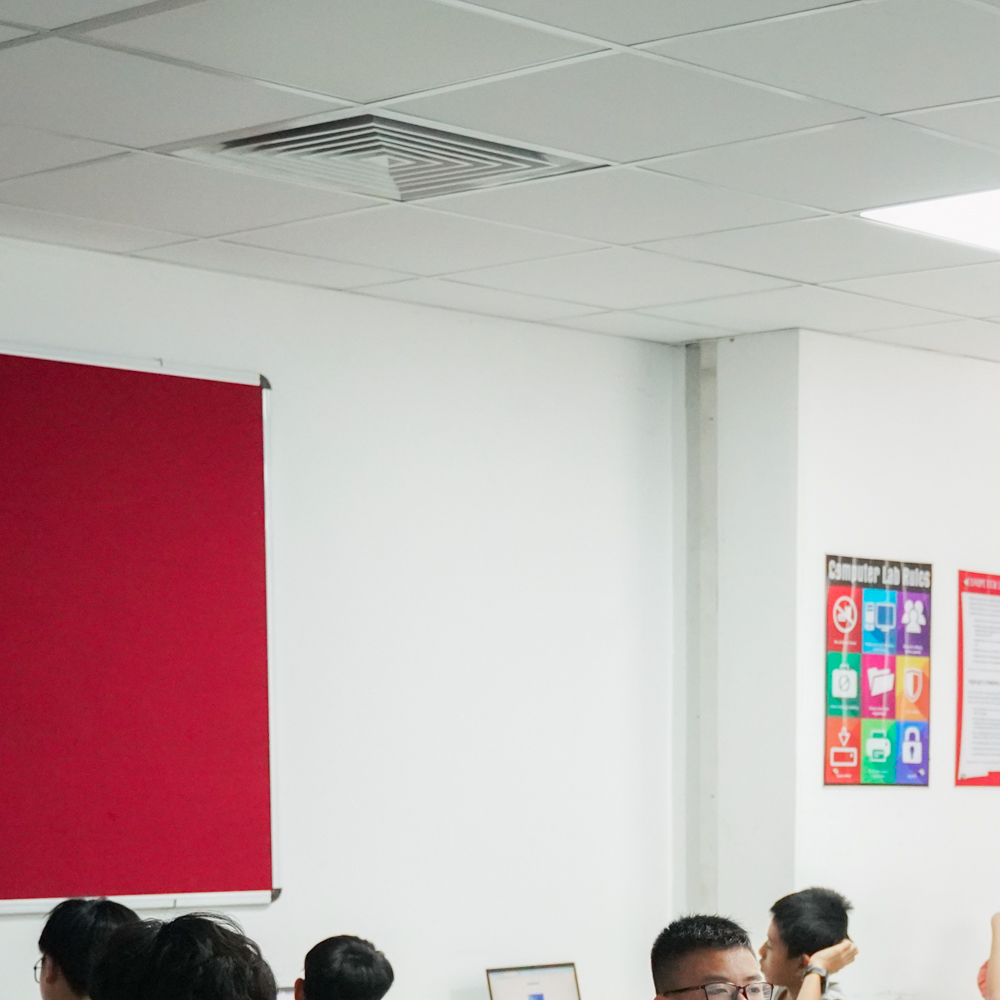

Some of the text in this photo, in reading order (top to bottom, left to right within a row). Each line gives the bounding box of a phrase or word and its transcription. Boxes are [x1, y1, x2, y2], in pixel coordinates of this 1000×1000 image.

[828, 559, 931, 588] Computer Lab Rules
